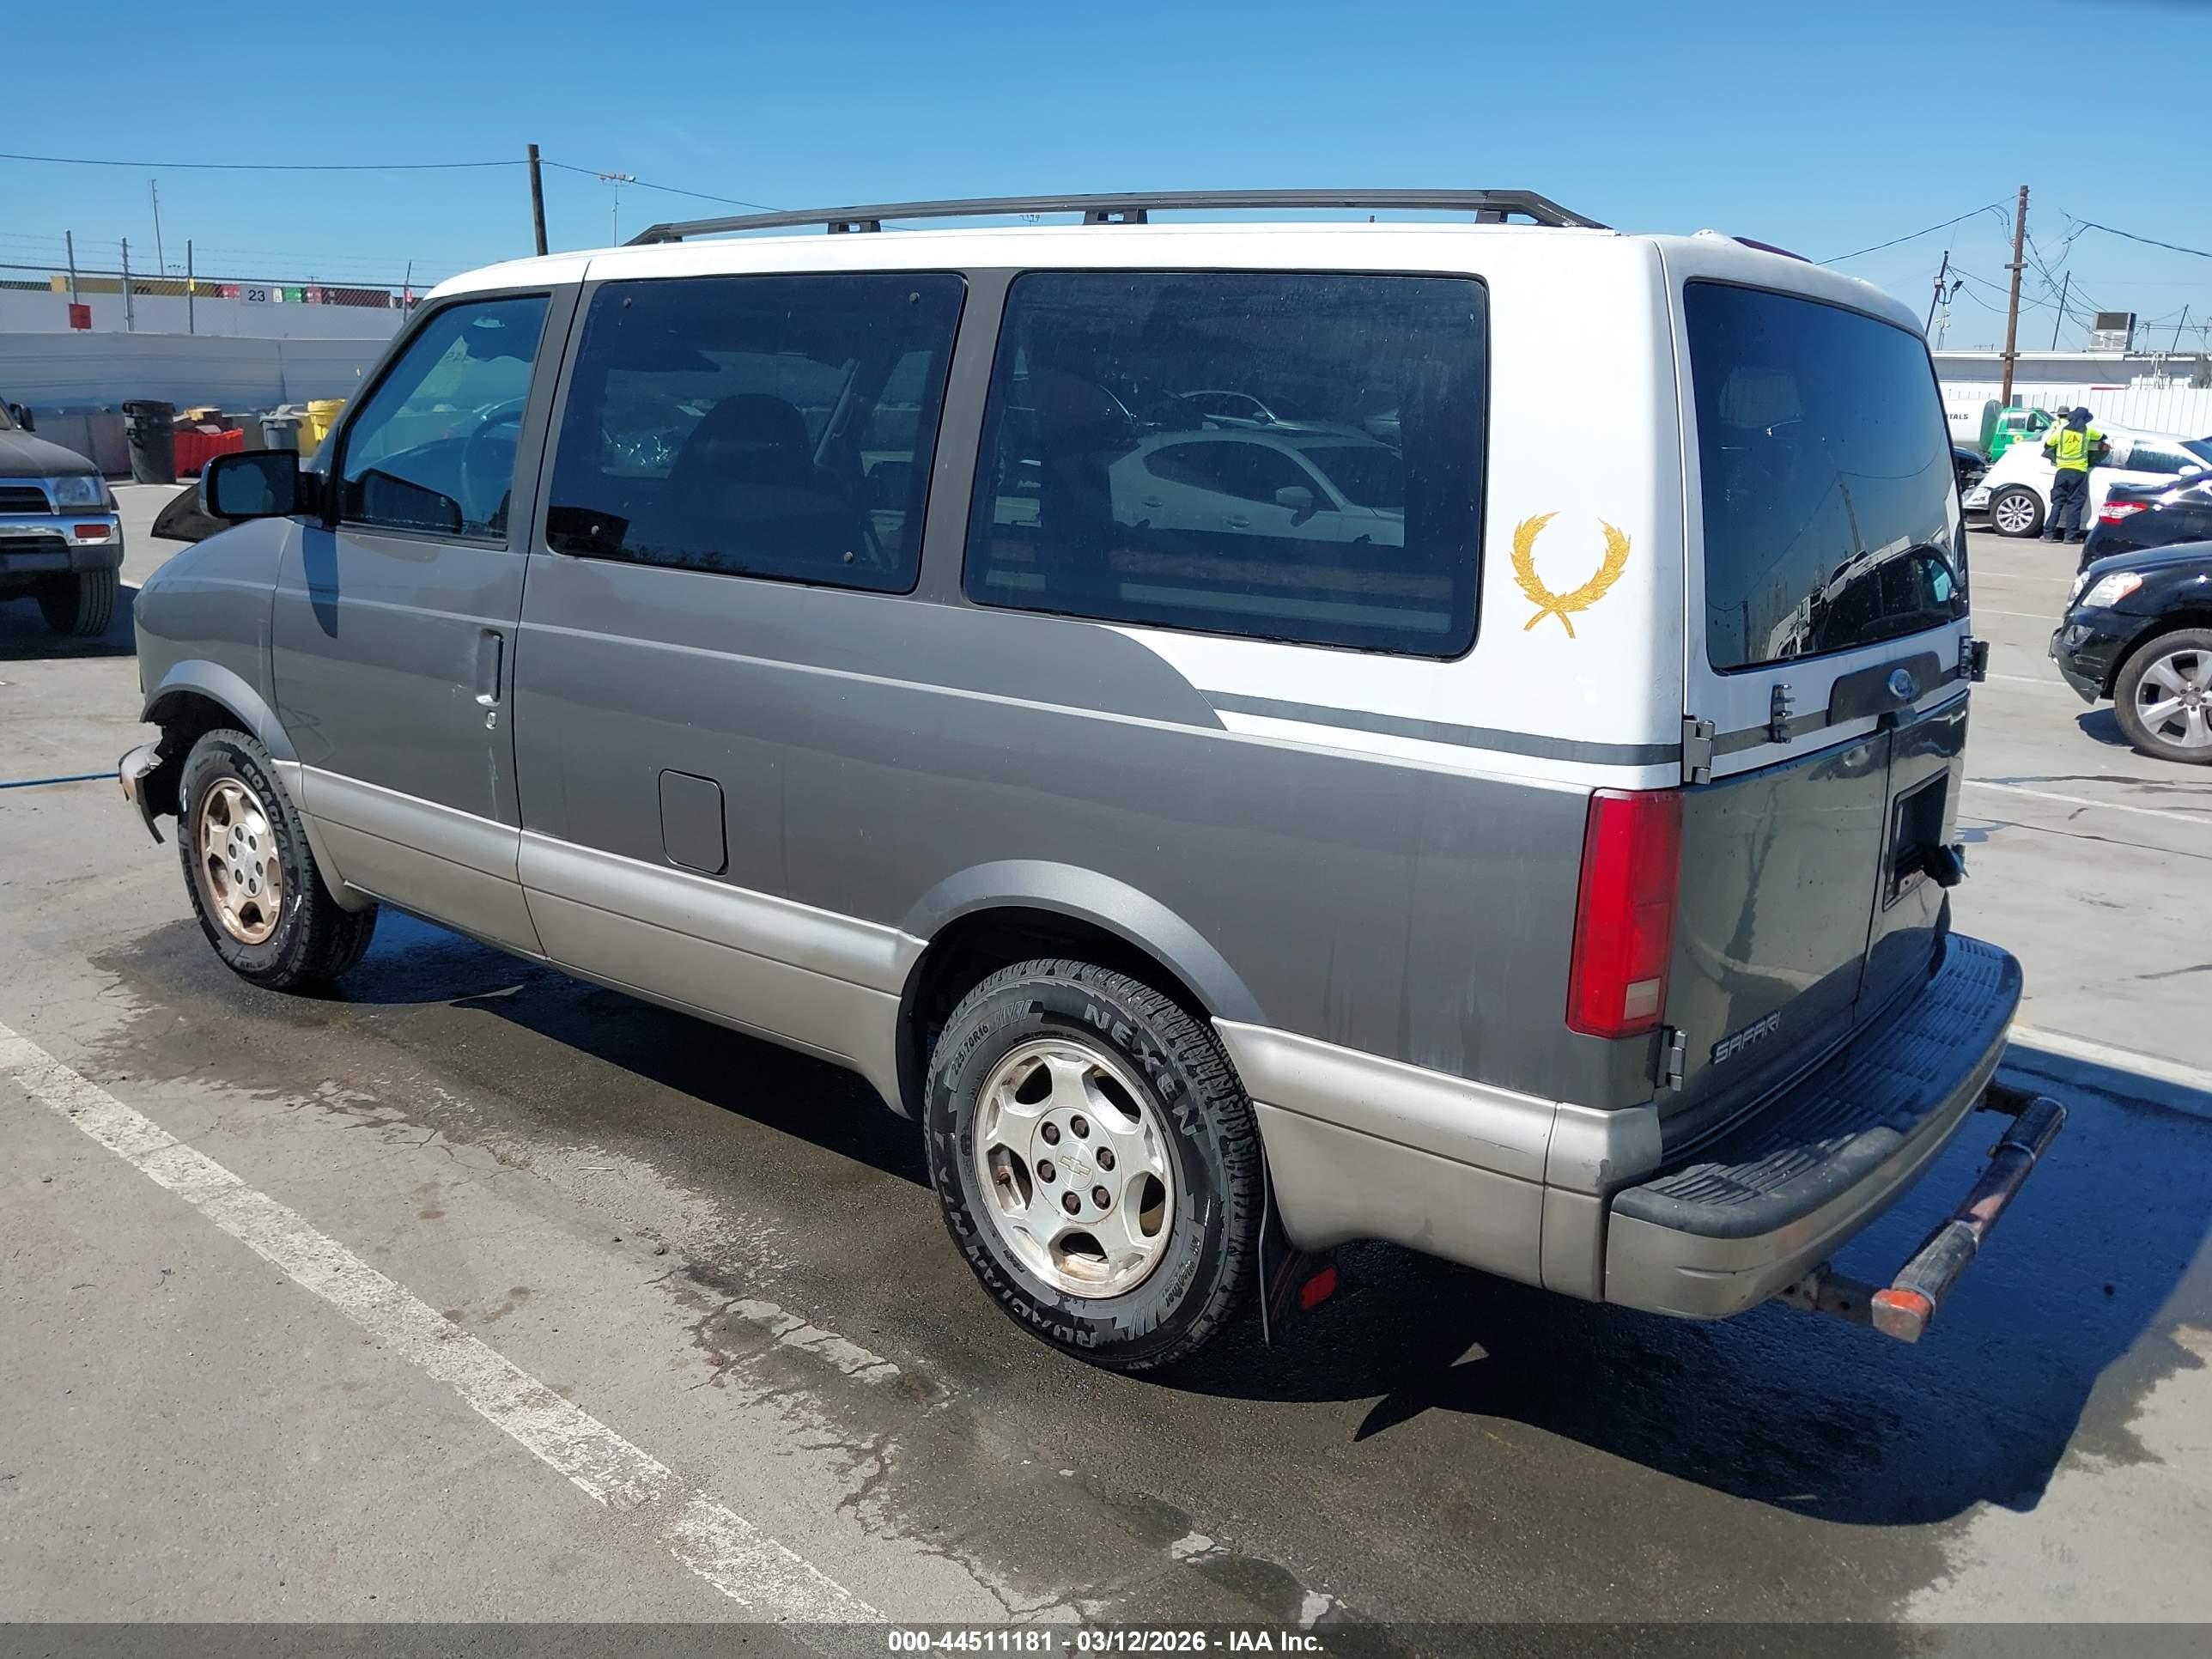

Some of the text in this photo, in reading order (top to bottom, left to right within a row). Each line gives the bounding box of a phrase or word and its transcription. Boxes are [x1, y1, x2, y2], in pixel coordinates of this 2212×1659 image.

[247, 289, 266, 302] 23
[1714, 1011, 1781, 1065] SAFARI
[1084, 1002, 1197, 1137] NEXEN
